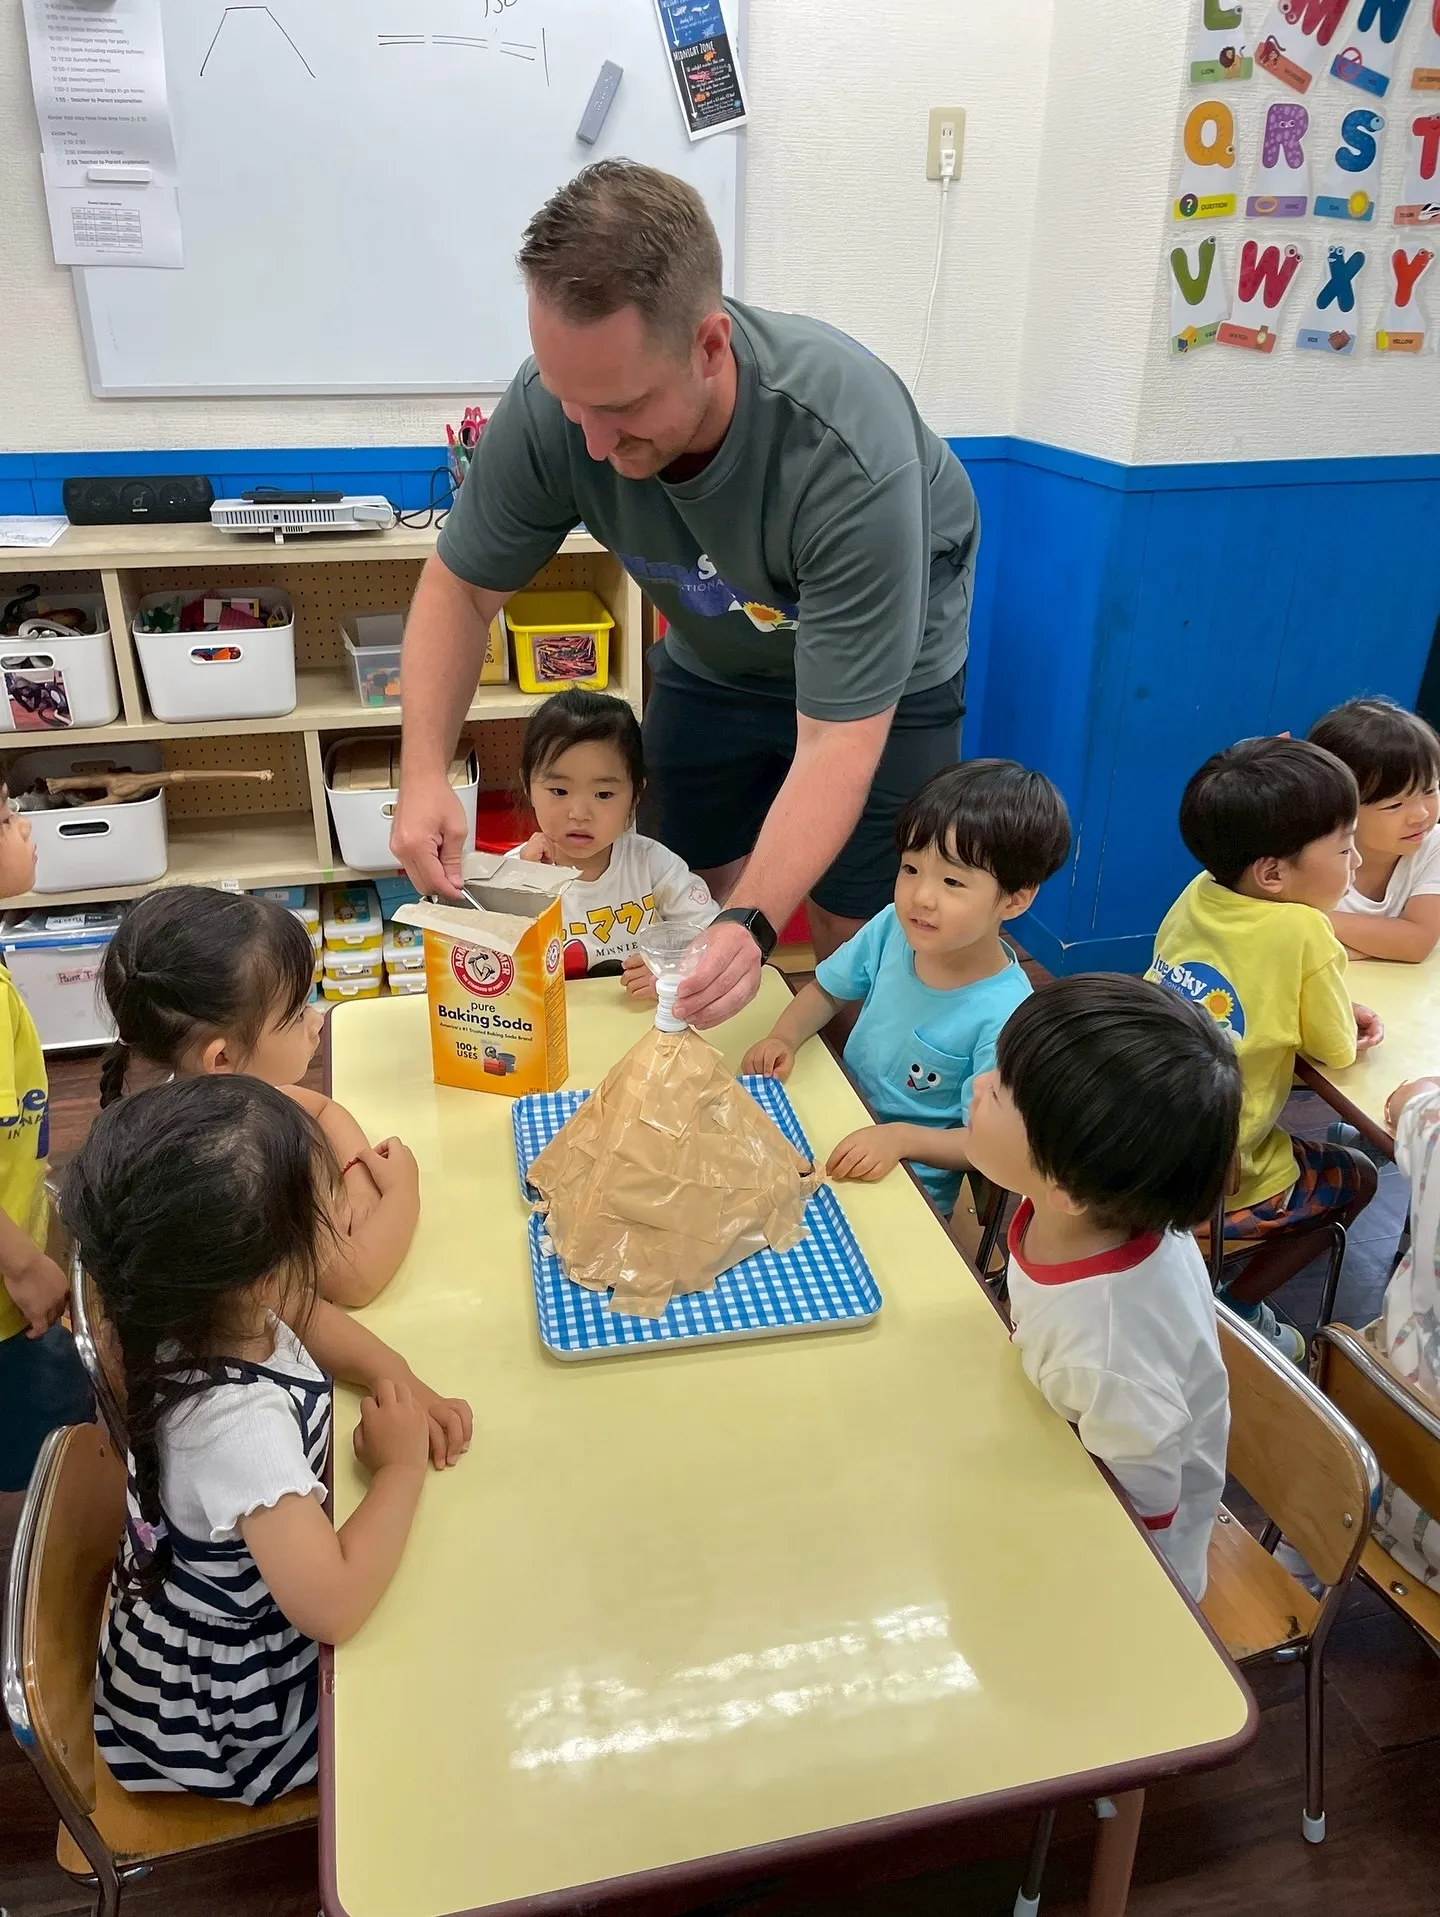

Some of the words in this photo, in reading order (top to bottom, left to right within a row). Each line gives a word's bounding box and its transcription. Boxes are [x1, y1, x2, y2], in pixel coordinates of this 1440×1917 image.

[672, 45, 700, 61] MIDNIGHT
[1184, 100, 1236, 168] Q
[1262, 103, 1309, 168] R
[1335, 109, 1385, 172] S
[1412, 112, 1440, 179] T
[1201, 202, 1228, 211] QUESTION
[1170, 235, 1217, 305] V
[1238, 240, 1303, 308] W
[1316, 245, 1366, 312] X
[1391, 248, 1435, 307] Y
[1229, 333, 1249, 341] WATCH
[595, 941, 639, 957] MINNIE
[1171, 965, 1208, 997] Sky
[438, 1004, 490, 1029] Baking
[492, 1014, 533, 1032] Soda
[470, 1002, 496, 1013] pure
[440, 1022, 462, 1031] America's
[469, 1027, 486, 1035] Trusted
[487, 1031, 504, 1039] Baking
[456, 1041, 478, 1052] 100+
[456, 1049, 478, 1060] USES
